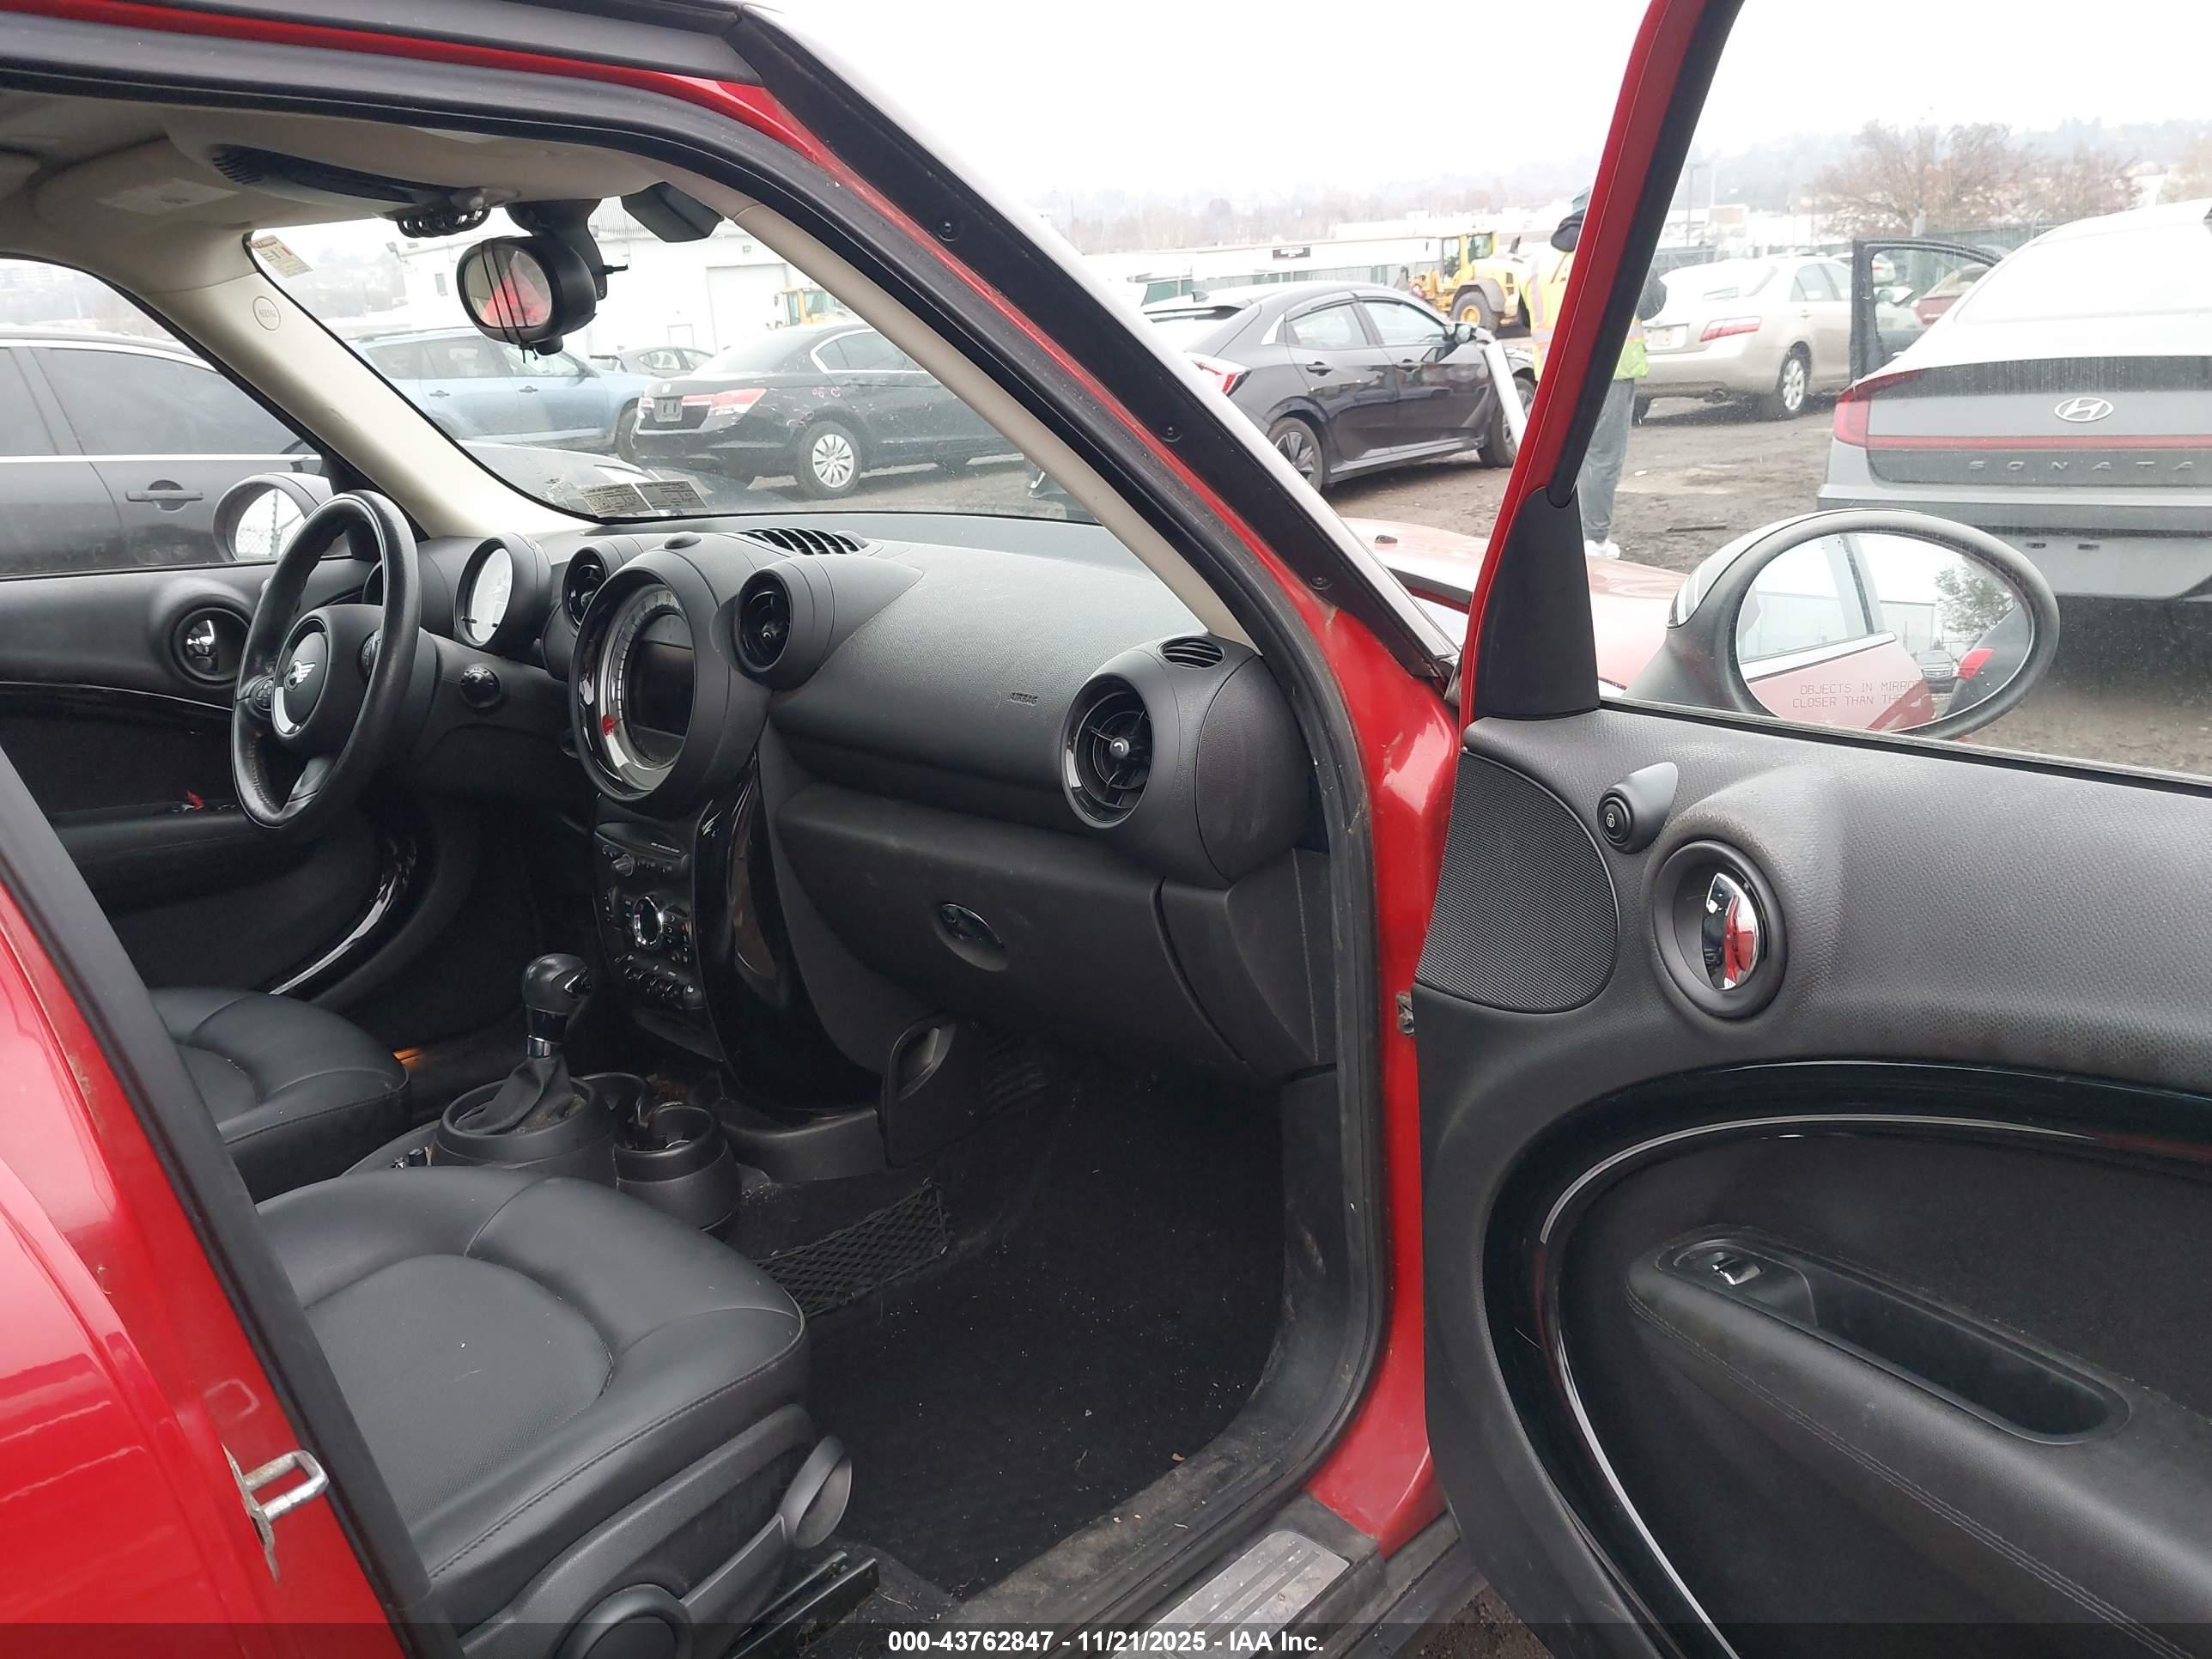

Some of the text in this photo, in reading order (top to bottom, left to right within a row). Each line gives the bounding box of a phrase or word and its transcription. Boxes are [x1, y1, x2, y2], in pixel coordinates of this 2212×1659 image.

[1969, 460, 2194, 471] SONATA
[1800, 683, 1852, 695] OBJECTS
[1861, 682, 1873, 693] IN
[1792, 694, 1904, 708] CLOSER THAN THE
